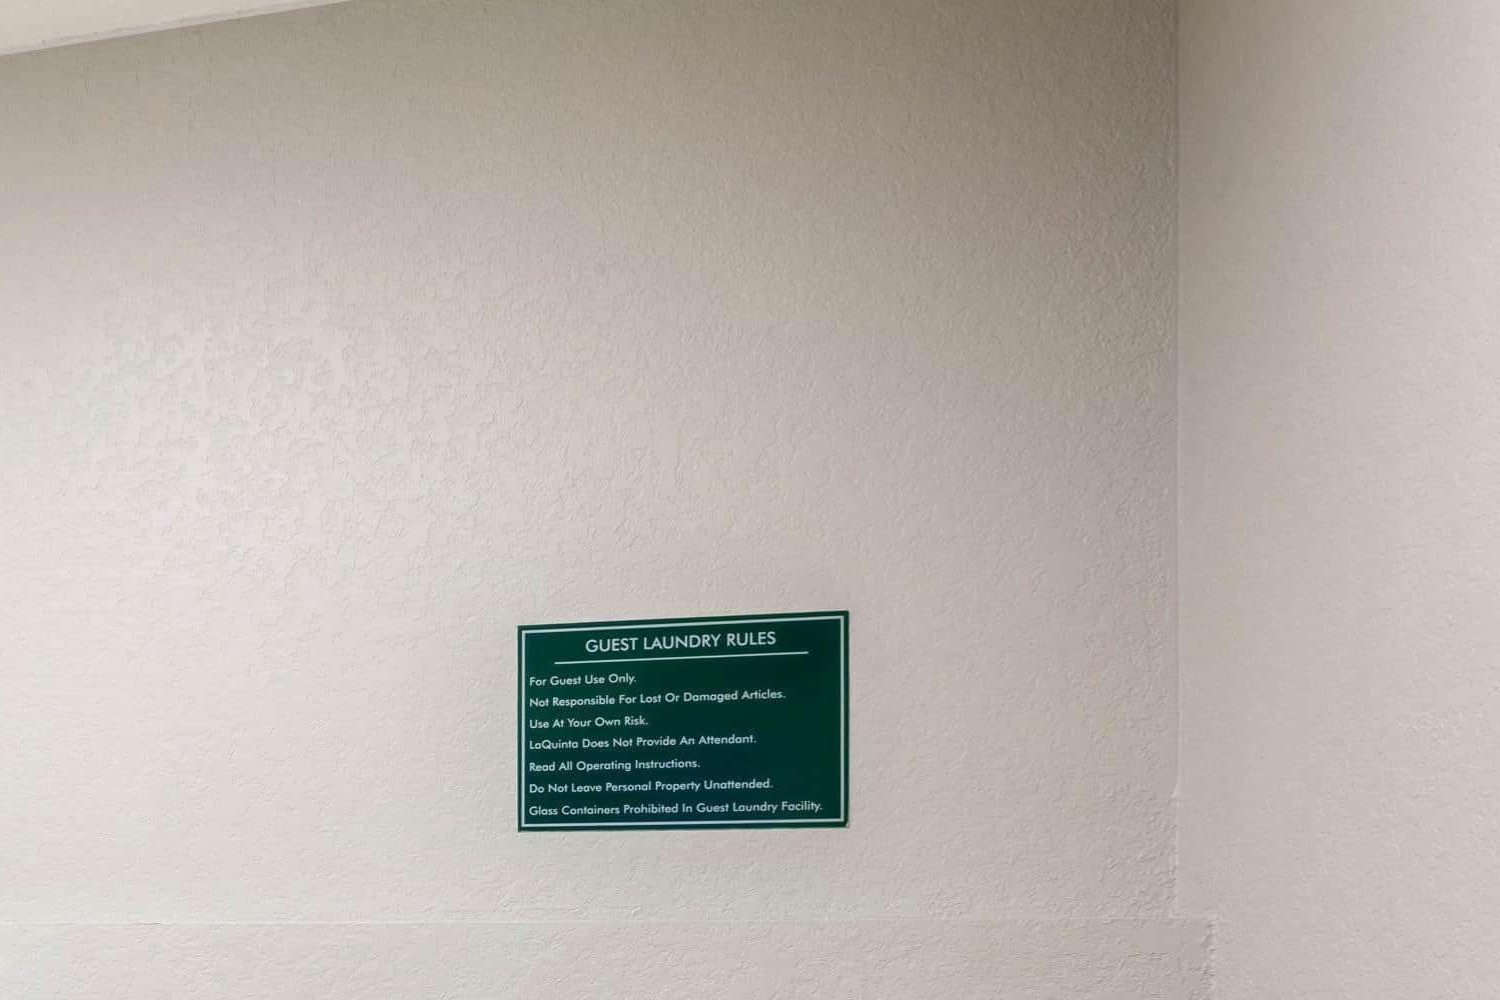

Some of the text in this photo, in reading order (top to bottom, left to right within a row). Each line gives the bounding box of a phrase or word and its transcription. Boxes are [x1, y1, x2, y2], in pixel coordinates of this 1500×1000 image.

[586, 631, 775, 653] GUEST LAUNDRY RULES
[530, 672, 636, 686] For Guest Use Only.
[530, 689, 786, 708] Not Responsible For Lost Or Damaged Articles.
[530, 715, 648, 729] Use At Your Own Risk.
[530, 734, 756, 750] LaQuinta Does Not Provide An Attendant.
[530, 758, 700, 772] Read All Operating Instructions.
[530, 778, 773, 794] Do Not Leave Personal Property Unattended.
[529, 800, 823, 816] Glass Containers Prohibited In Guest Laundry Facility.
